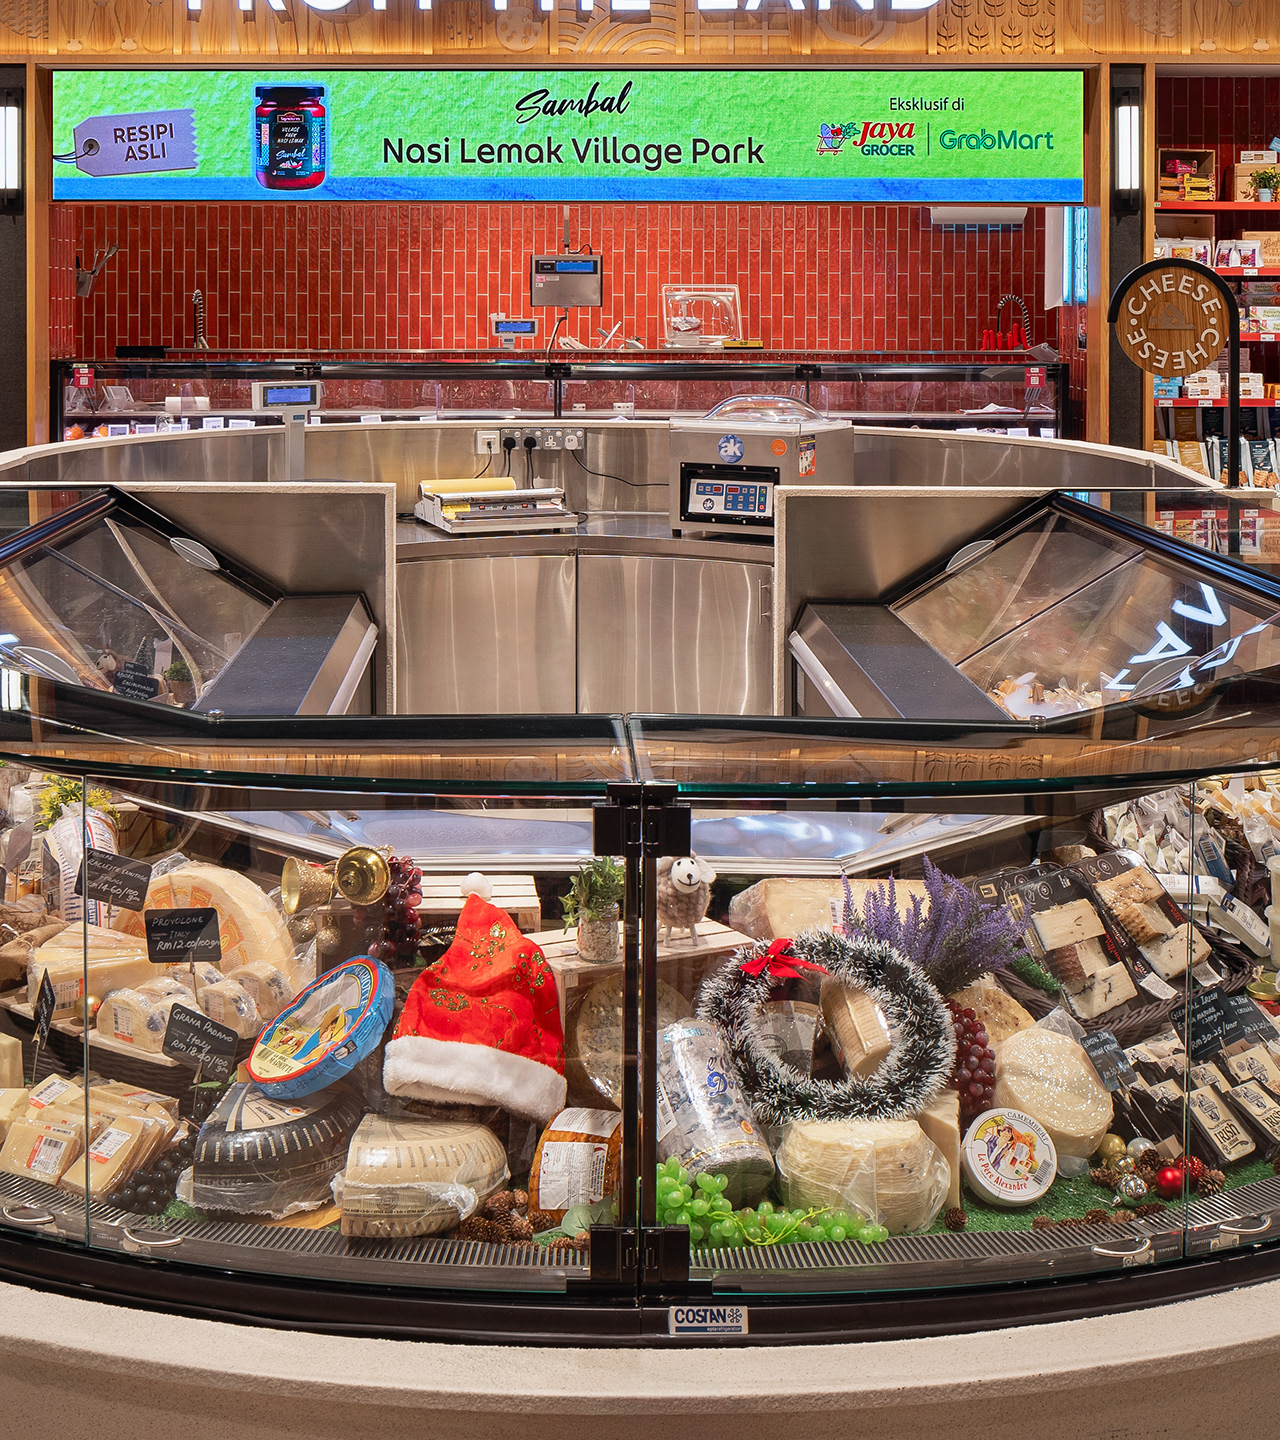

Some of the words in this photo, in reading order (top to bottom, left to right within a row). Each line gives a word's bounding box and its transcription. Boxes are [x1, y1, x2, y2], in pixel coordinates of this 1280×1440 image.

[516, 80, 633, 124] Sambal
[889, 97, 950, 111] Eksklusif
[952, 97, 965, 111] di
[113, 123, 174, 144] RESIPI
[853, 121, 915, 146] Jaya
[939, 128, 1054, 150] GrabMart
[125, 142, 167, 162] ASLI
[383, 137, 450, 164] Nasi
[460, 137, 564, 164] Lemak
[571, 137, 683, 171] Village
[692, 137, 765, 164] Park
[861, 144, 915, 156] GROCER
[1128, 274, 1222, 315] CHEESE
[1127, 328, 1220, 370] CHEESE
[720, 439, 741, 456] ak
[152, 916, 204, 927] PROVOLONE
[172, 1008, 201, 1029] GRANA
[202, 1021, 234, 1044] PADANO
[186, 1032, 212, 1054] Italy
[1007, 1111, 1049, 1142] CAMEMBERT
[994, 1176, 1028, 1191] Alexandre
[674, 1308, 727, 1324] COSTAN
